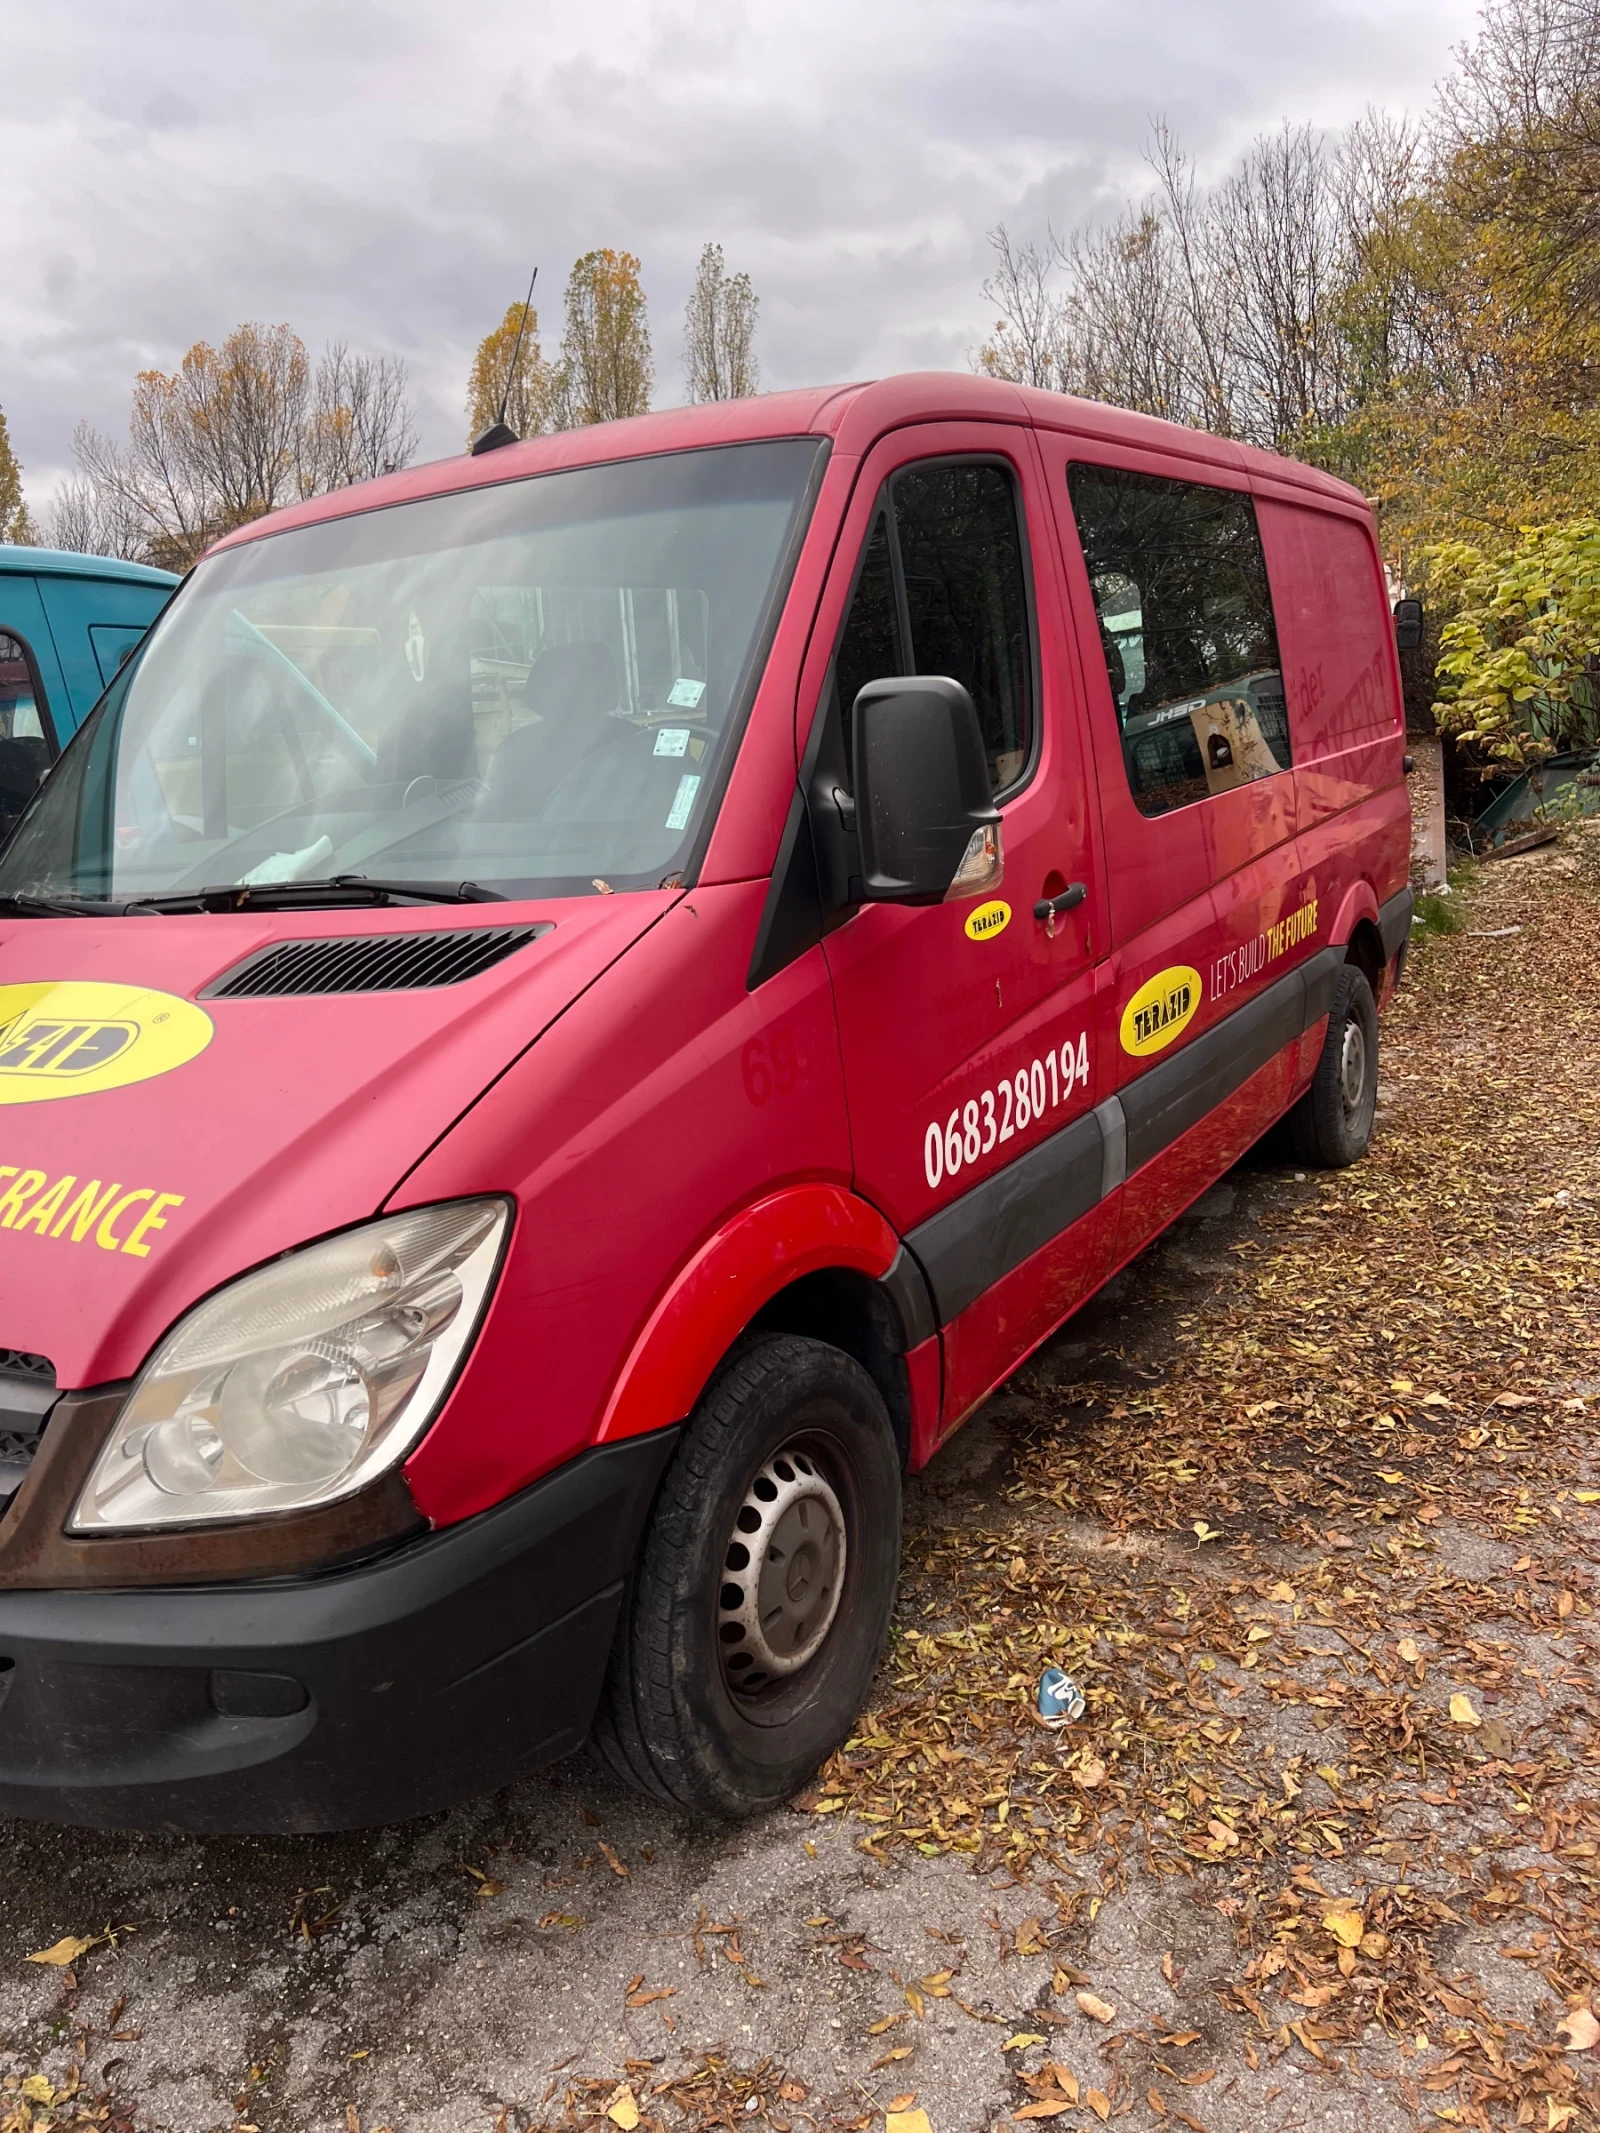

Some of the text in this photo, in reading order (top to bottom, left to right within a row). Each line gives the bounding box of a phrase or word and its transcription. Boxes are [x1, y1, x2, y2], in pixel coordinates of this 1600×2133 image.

[972, 908, 1005, 935] TERAZID
[1210, 899, 1319, 1002] LET'S BUILD THE FUTURE
[1133, 983, 1191, 1046] TERAZID
[924, 1031, 1090, 1188] 0683280194
